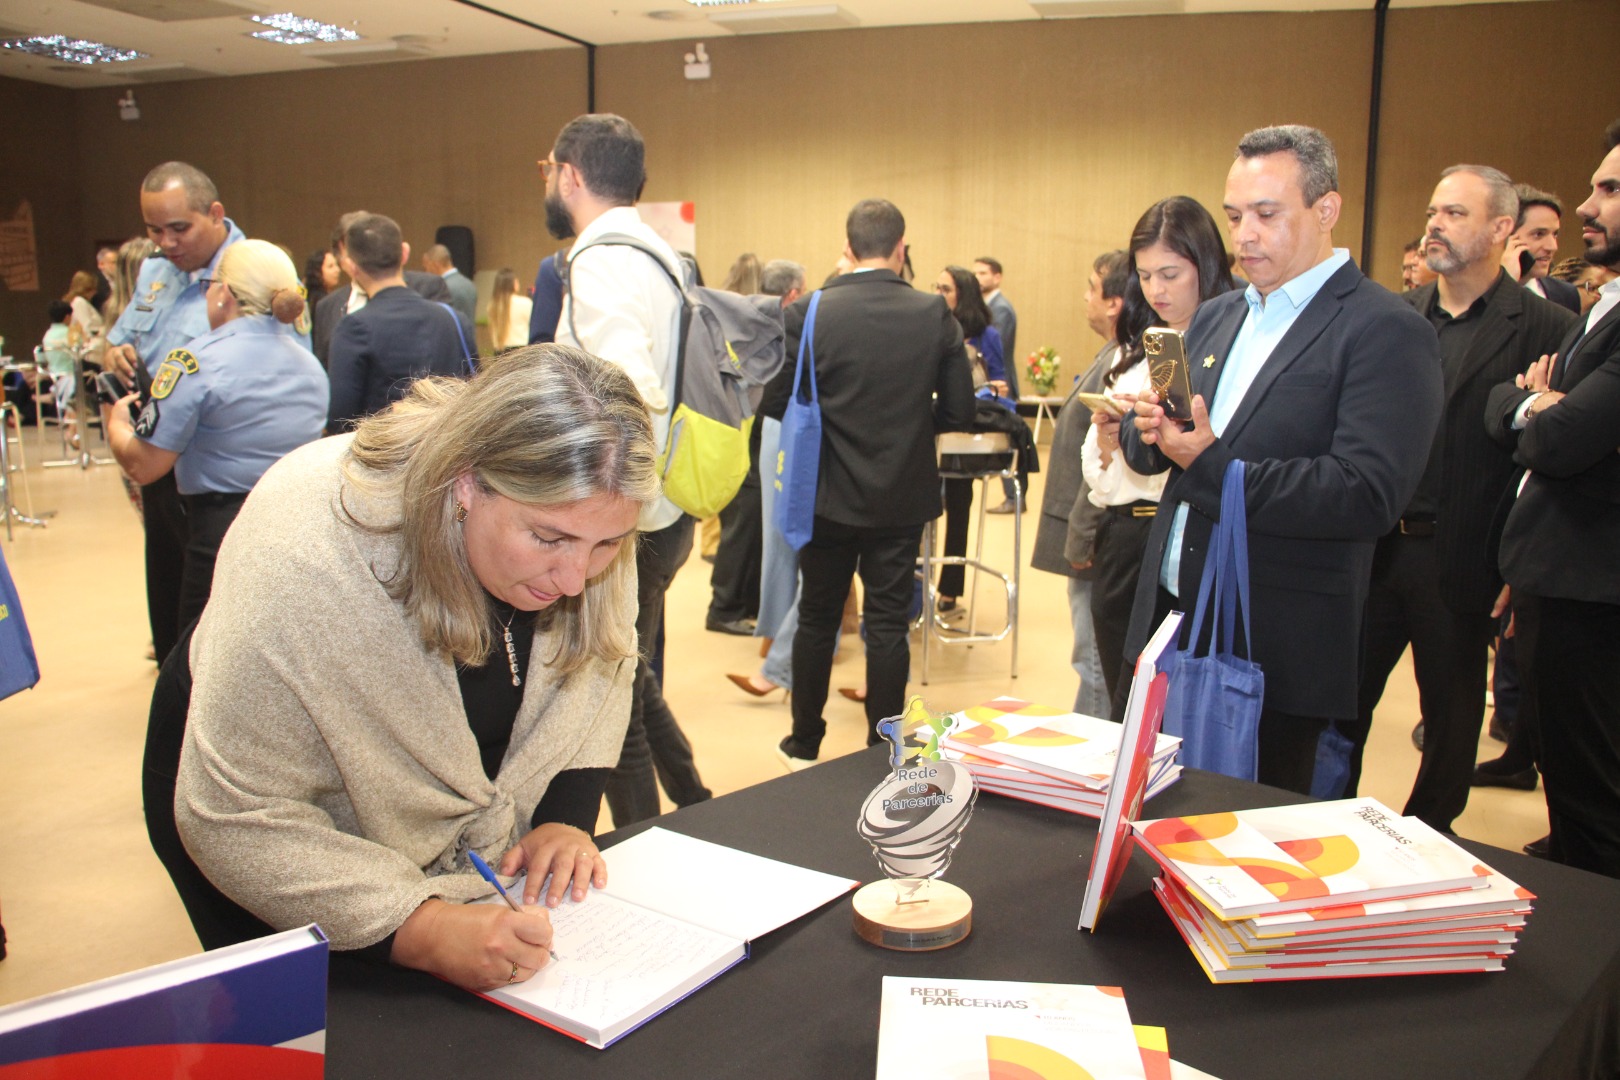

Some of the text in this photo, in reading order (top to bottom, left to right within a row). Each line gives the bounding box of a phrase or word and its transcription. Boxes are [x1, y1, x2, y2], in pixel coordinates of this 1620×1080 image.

[898, 766, 938, 782] Rede
[908, 782, 928, 794] de
[882, 792, 954, 811] Parcerias
[1360, 806, 1392, 822] REDE
[910, 987, 959, 998] REDE
